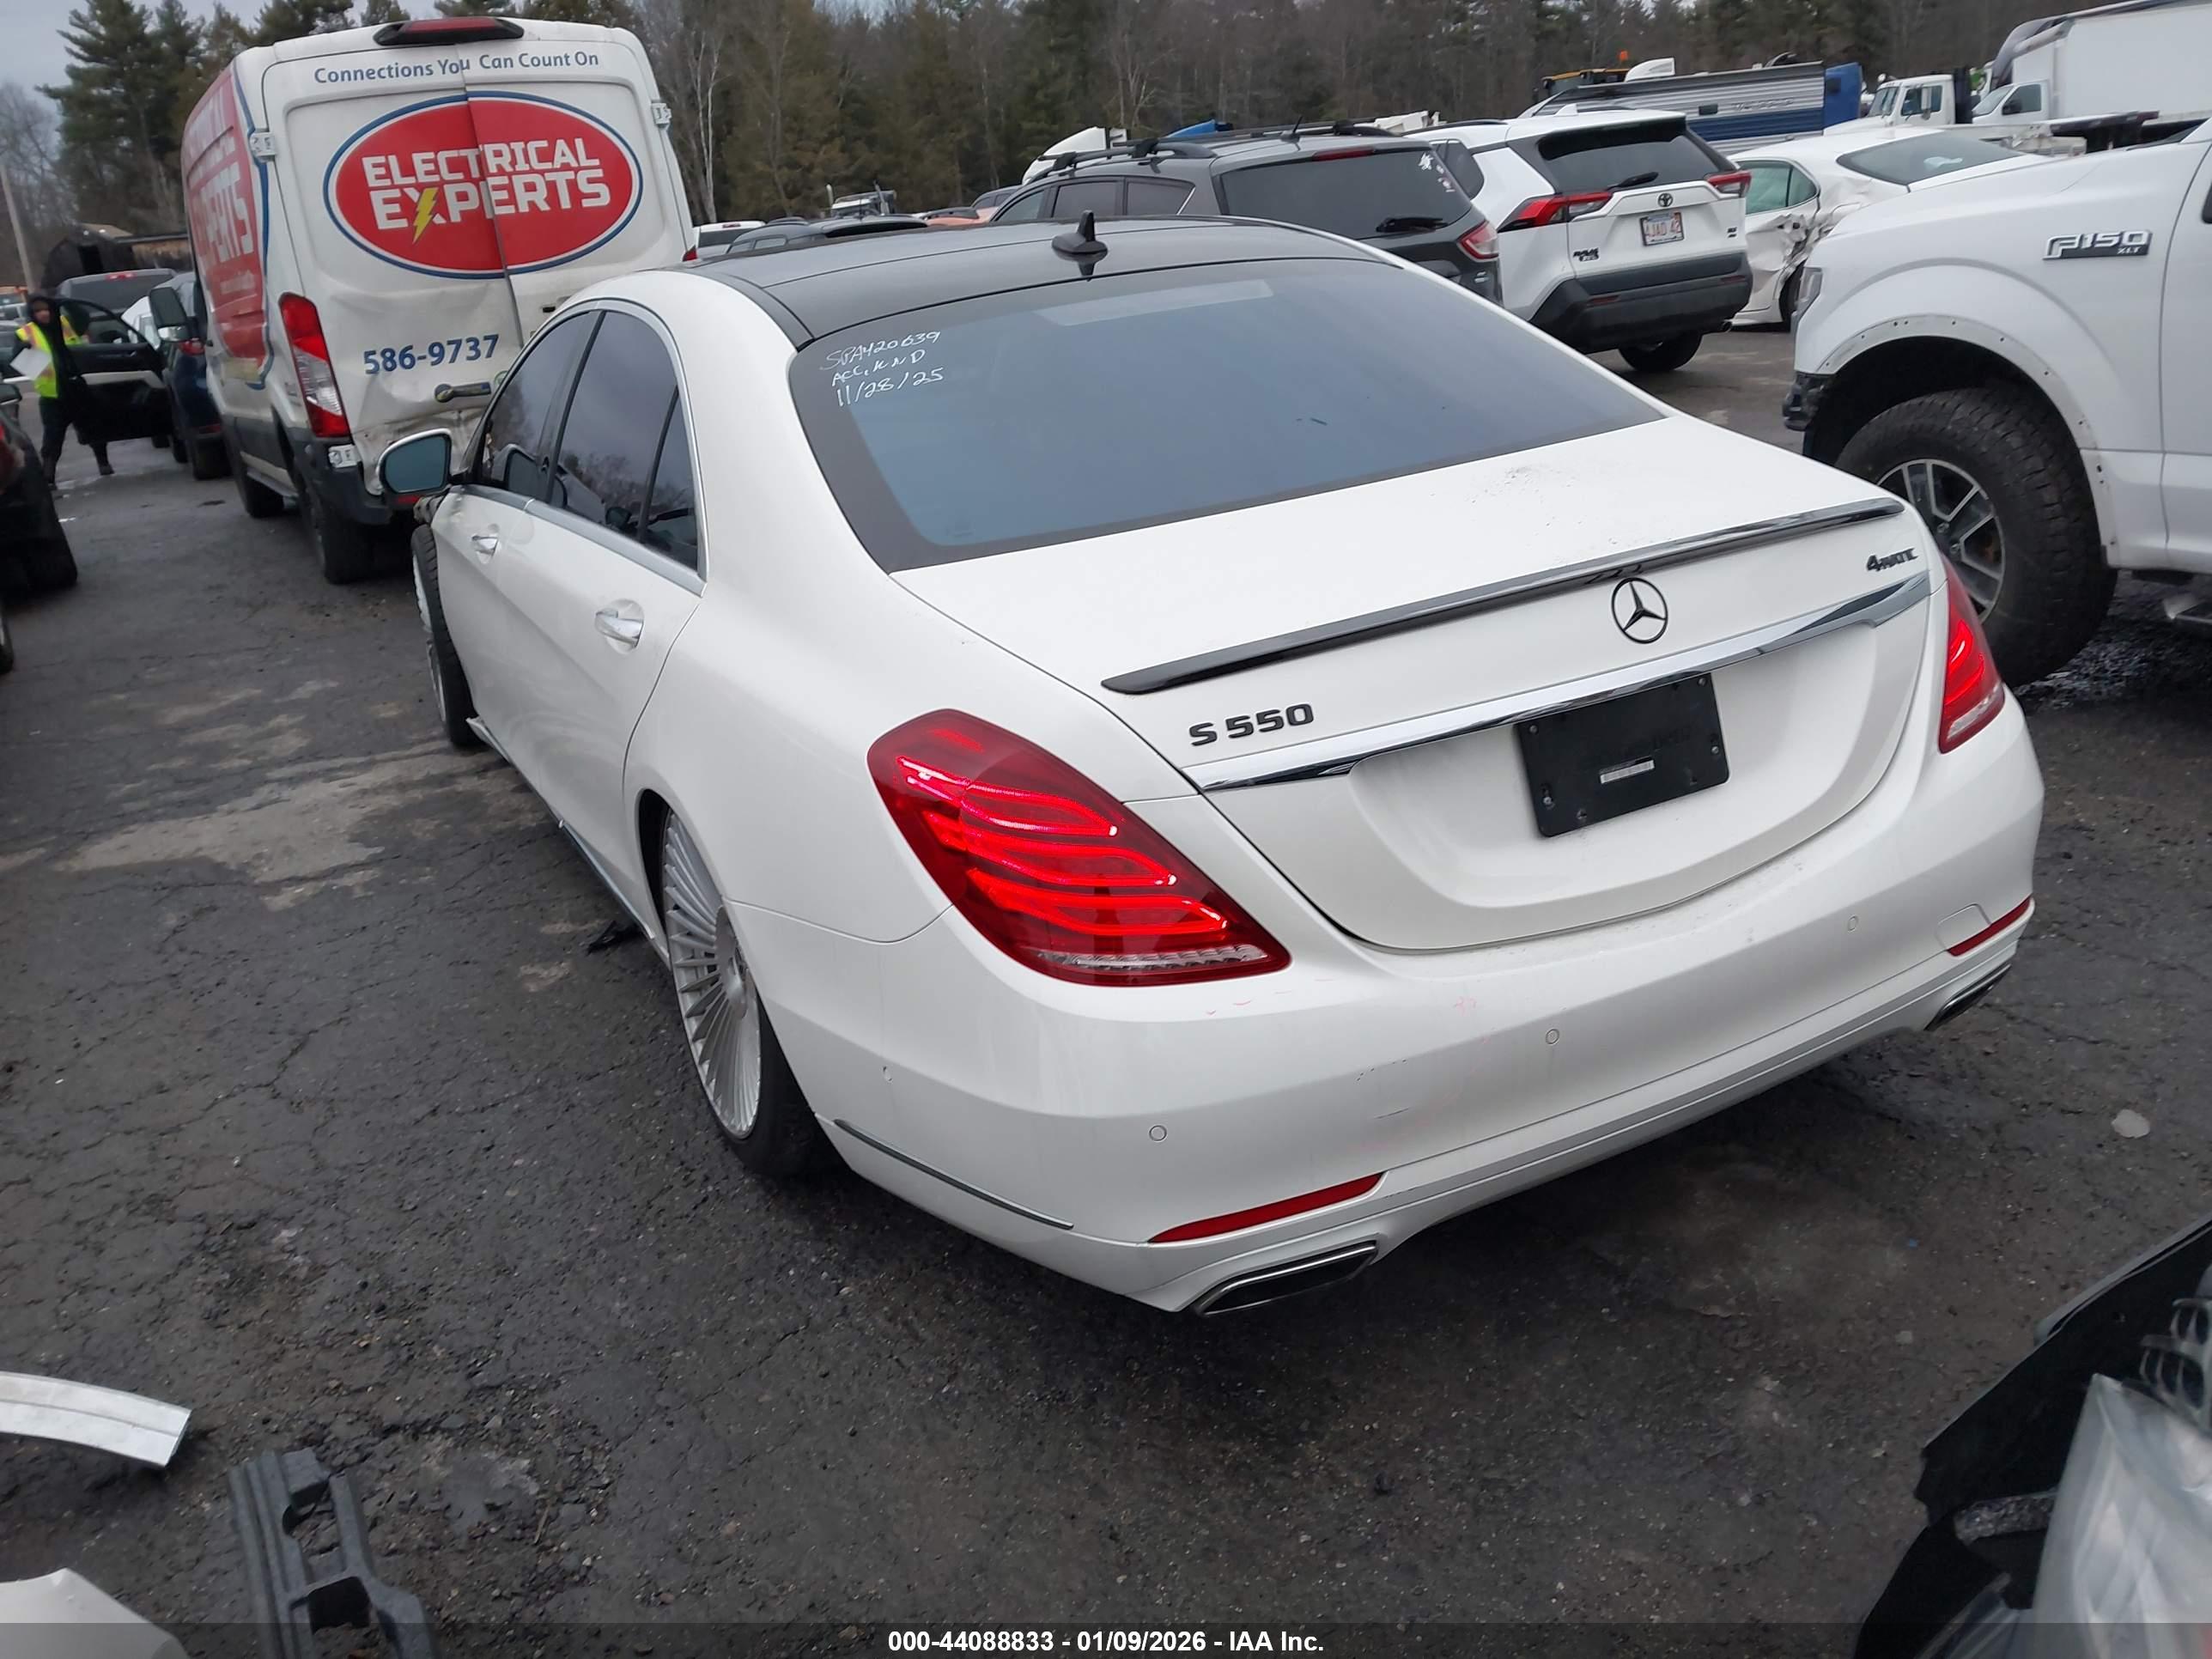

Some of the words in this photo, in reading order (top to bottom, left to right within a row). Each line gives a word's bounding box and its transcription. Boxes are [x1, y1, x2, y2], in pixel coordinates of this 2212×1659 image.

[314, 60, 434, 83] Connections
[437, 58, 471, 76] You
[479, 54, 514, 70] Can
[519, 52, 570, 68] Count
[574, 51, 599, 66] On
[362, 137, 601, 187] ELECTRICAL
[369, 168, 611, 230] EXPERTS
[2117, 246, 2142, 255] XLT
[363, 333, 500, 375] 586-9737
[1188, 722, 1218, 747] S
[1225, 703, 1315, 738] 550
